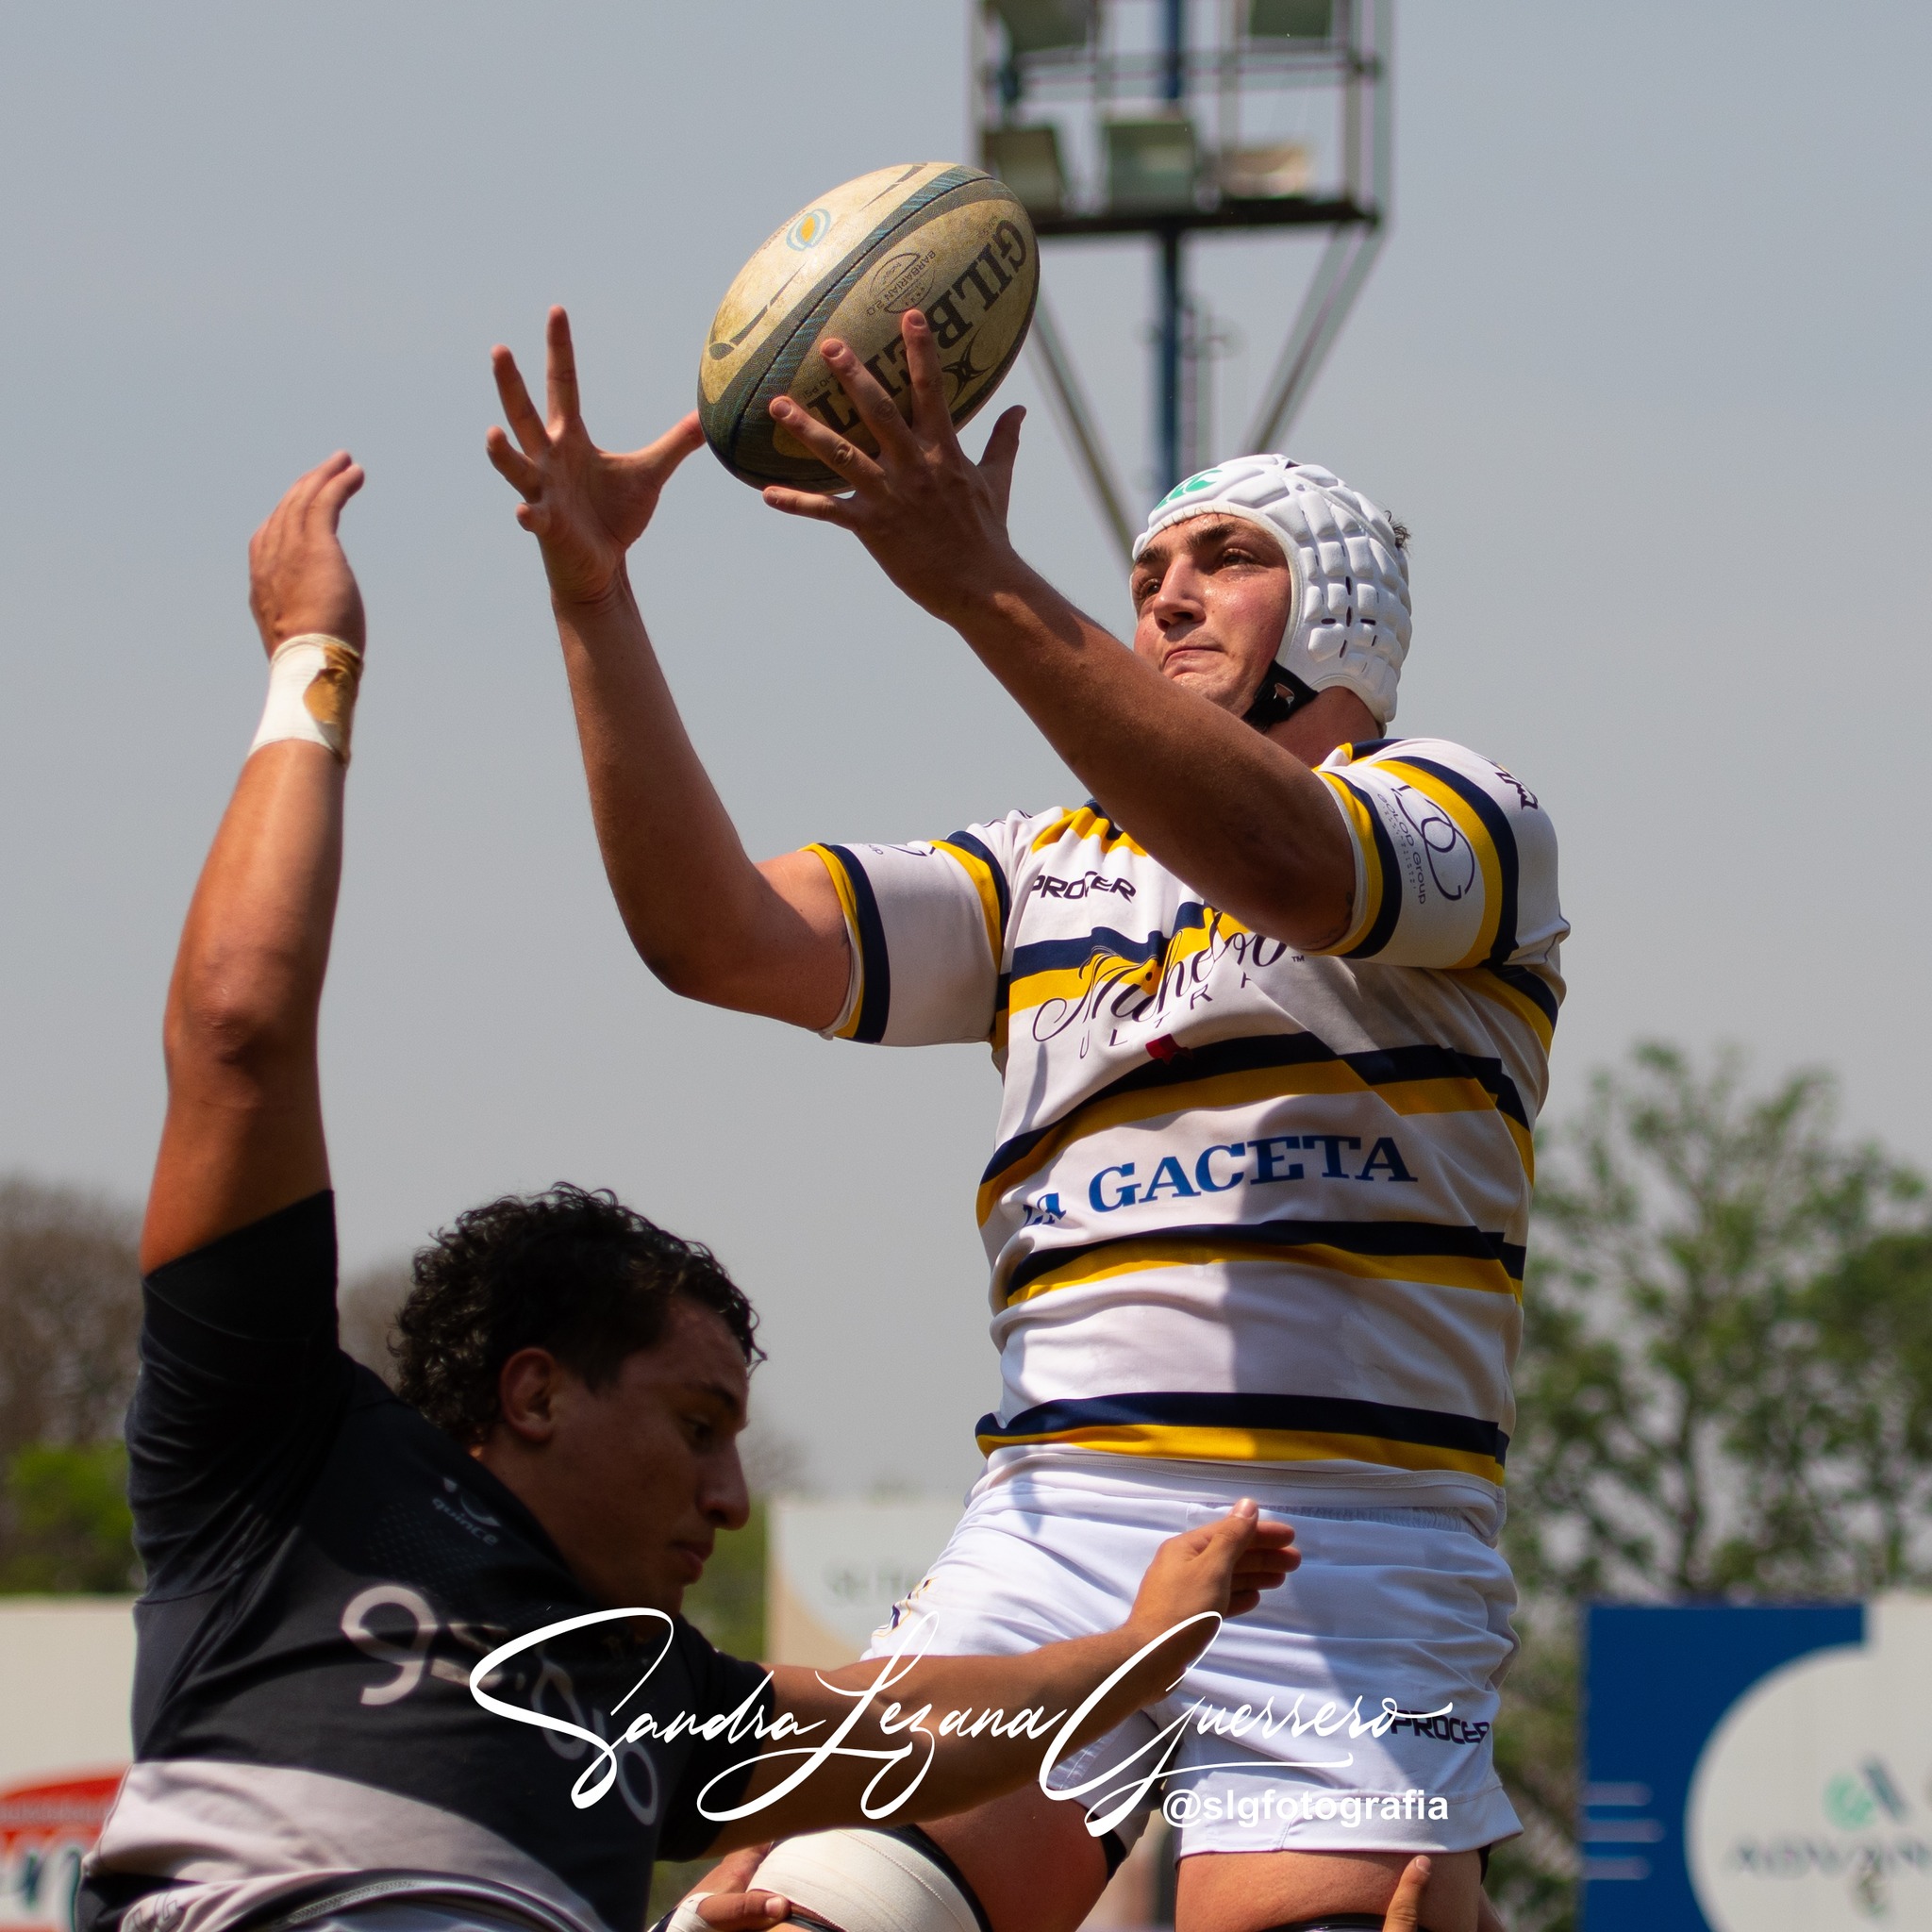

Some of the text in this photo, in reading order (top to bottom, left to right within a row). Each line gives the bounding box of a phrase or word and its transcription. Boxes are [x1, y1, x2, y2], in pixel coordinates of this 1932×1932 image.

[885, 250, 936, 301] BARBARIAN
[1412, 852, 1425, 904] Group
[1089, 1134, 1419, 1213] GACETA
